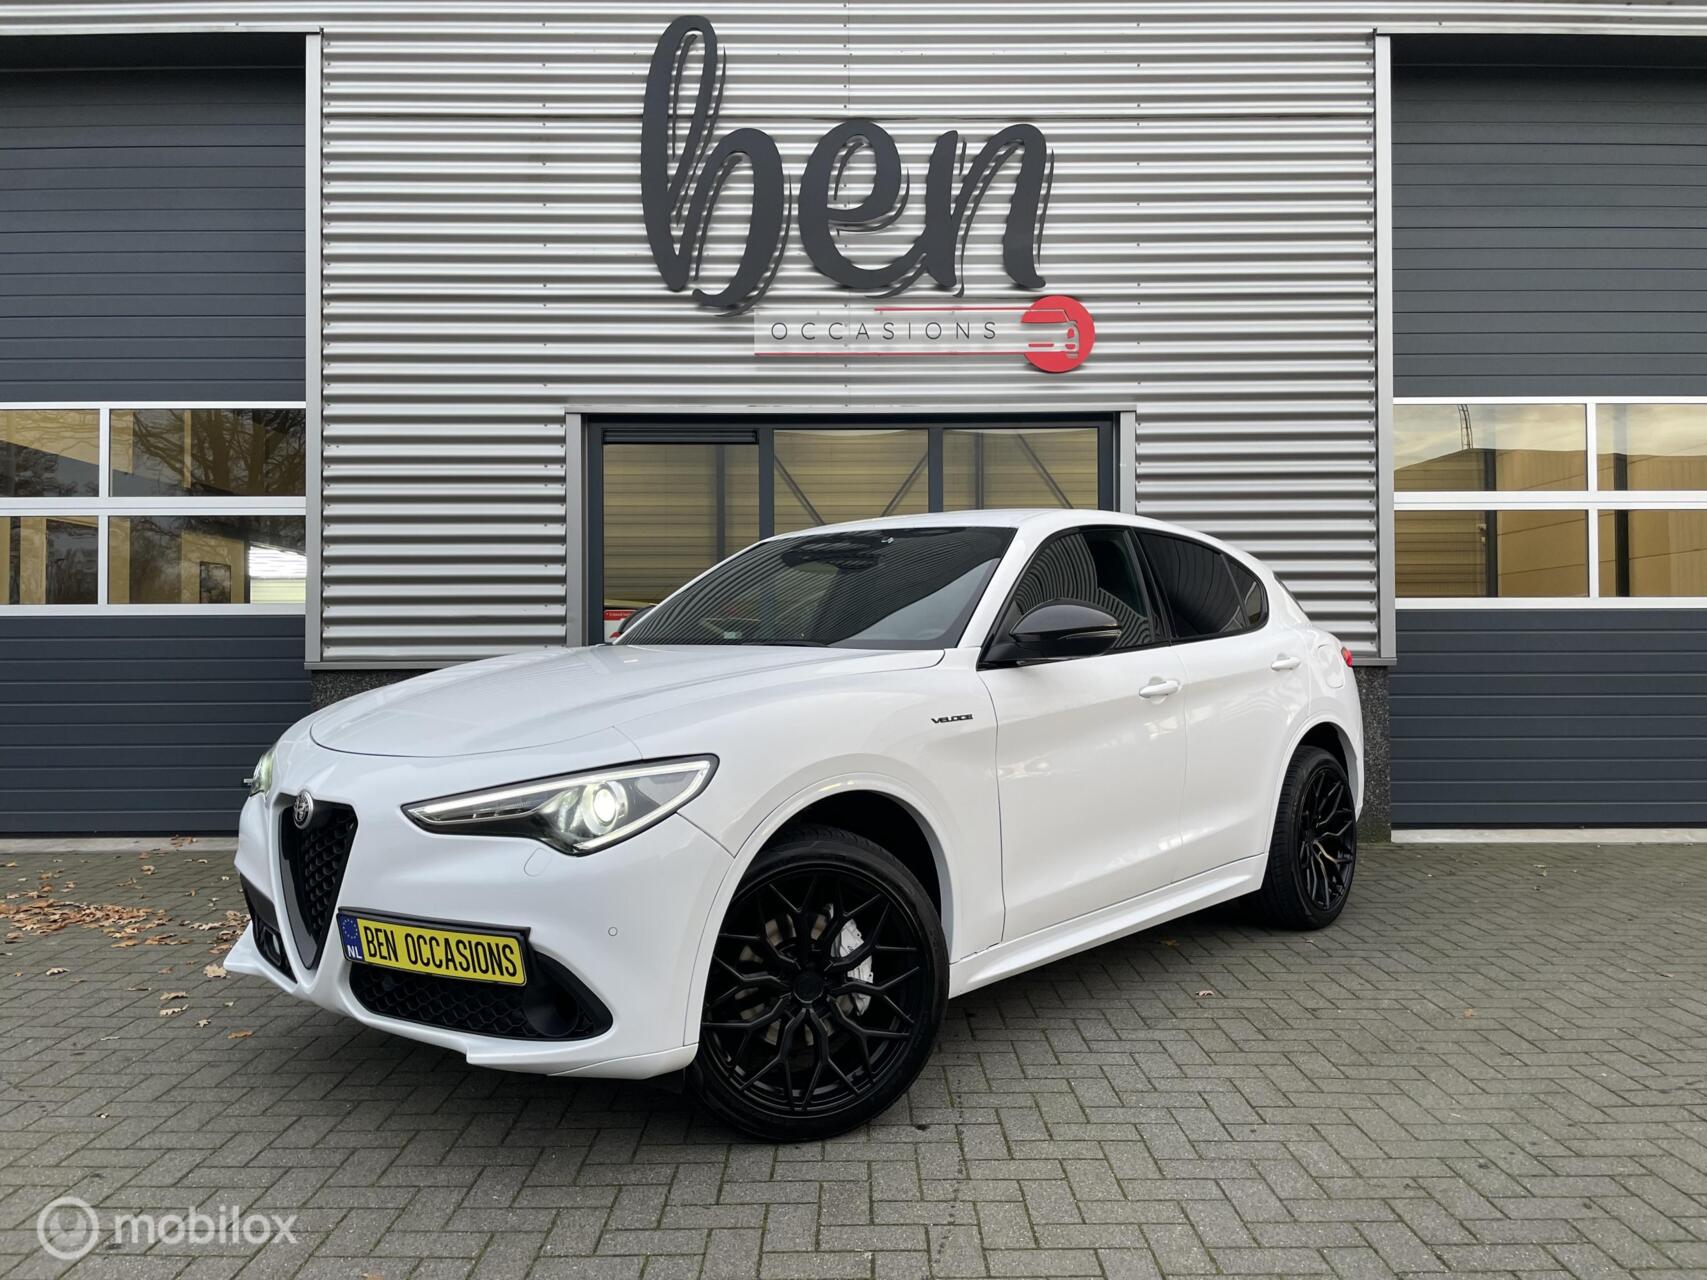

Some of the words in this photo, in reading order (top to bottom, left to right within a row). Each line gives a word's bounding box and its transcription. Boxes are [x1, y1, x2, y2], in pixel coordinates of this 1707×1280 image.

[641, 15, 1055, 316] ben
[770, 321, 996, 341] OCCASIONS
[930, 713, 974, 724] VELOCE
[346, 944, 363, 960] NL
[363, 925, 399, 963] BEN
[404, 932, 518, 978] OCCASIONS
